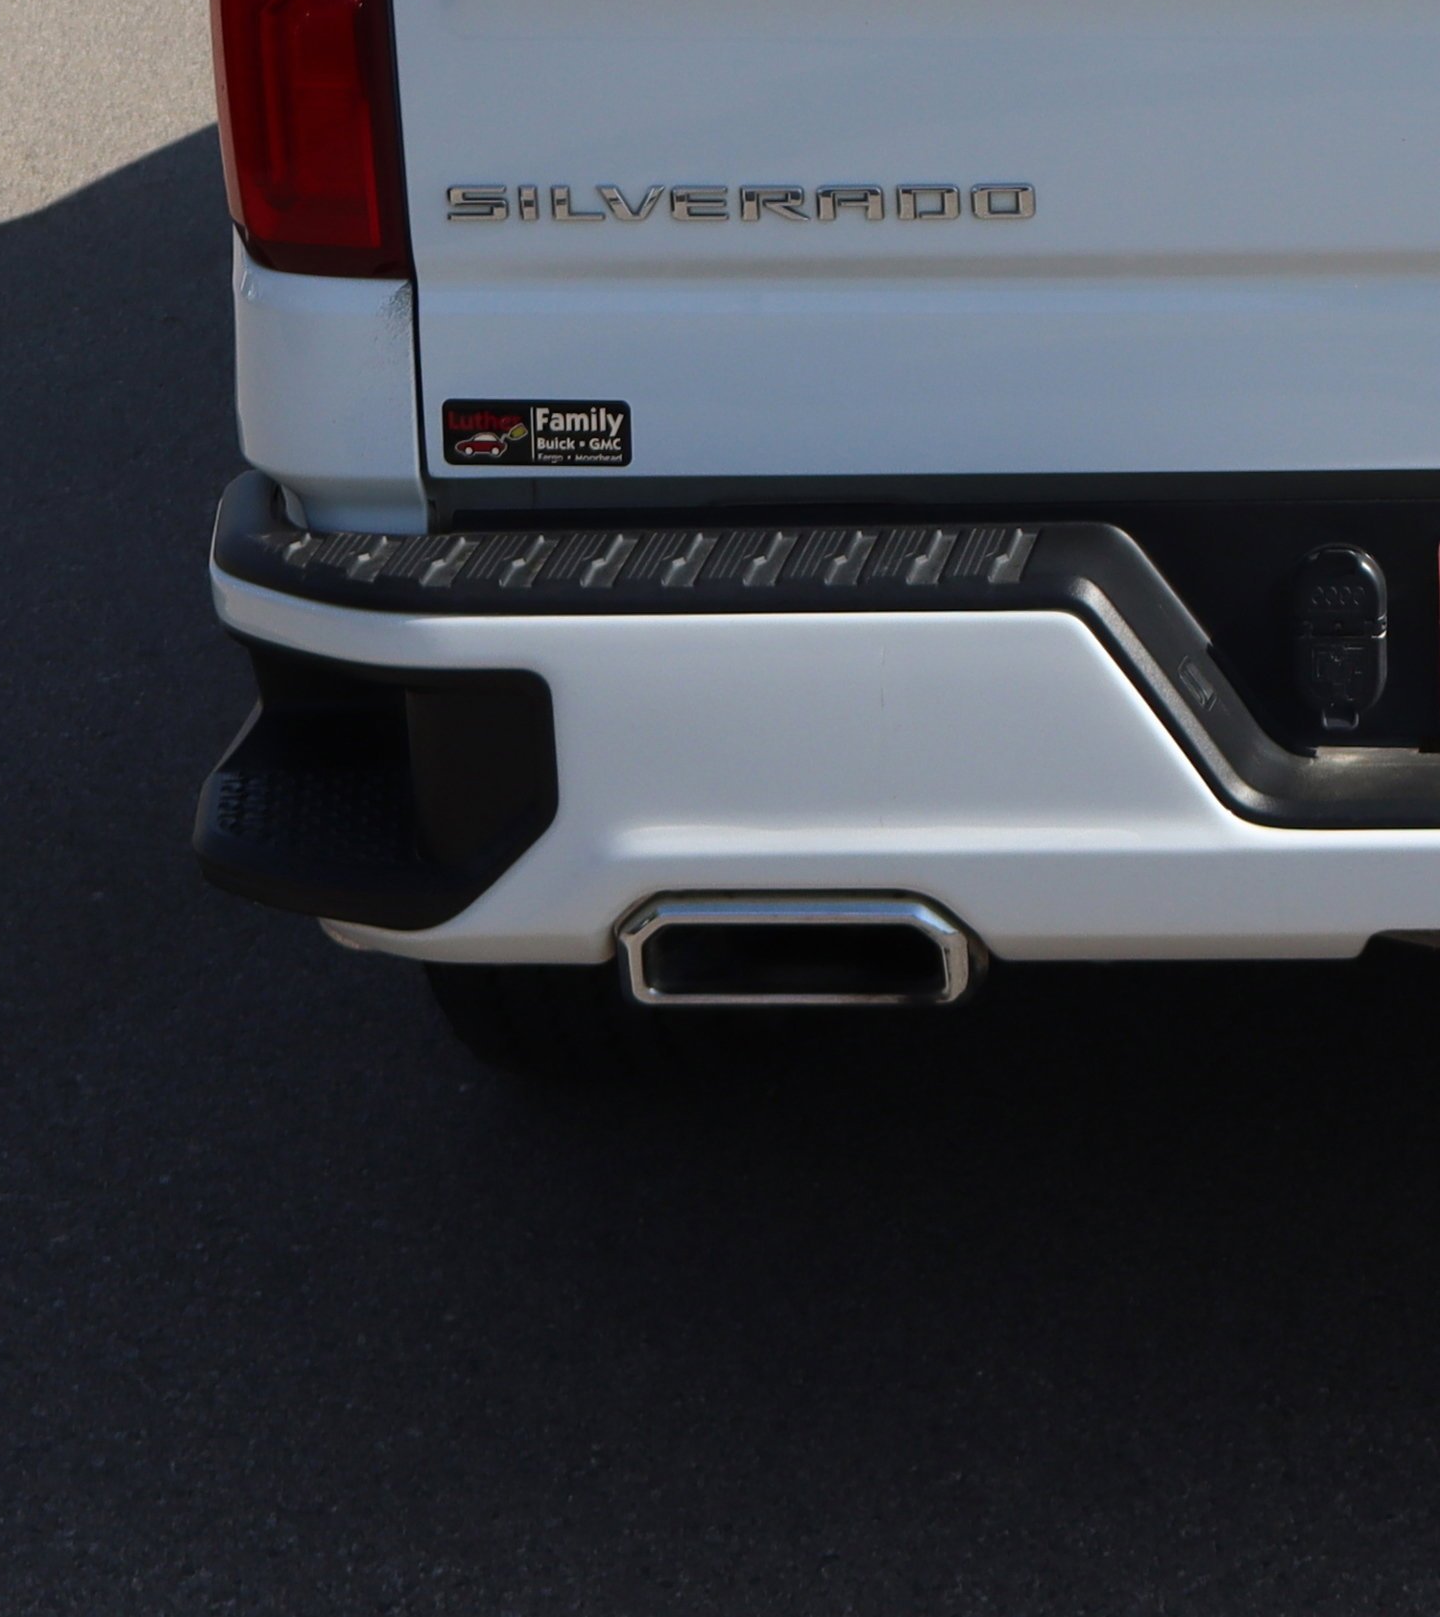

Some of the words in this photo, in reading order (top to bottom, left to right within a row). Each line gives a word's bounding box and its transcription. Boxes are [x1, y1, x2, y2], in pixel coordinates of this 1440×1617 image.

[446, 185, 1037, 221] SILVERADO
[448, 411, 523, 431] Luther
[535, 407, 625, 437] Family
[537, 437, 575, 451] Buick
[589, 438, 622, 451] GMC
